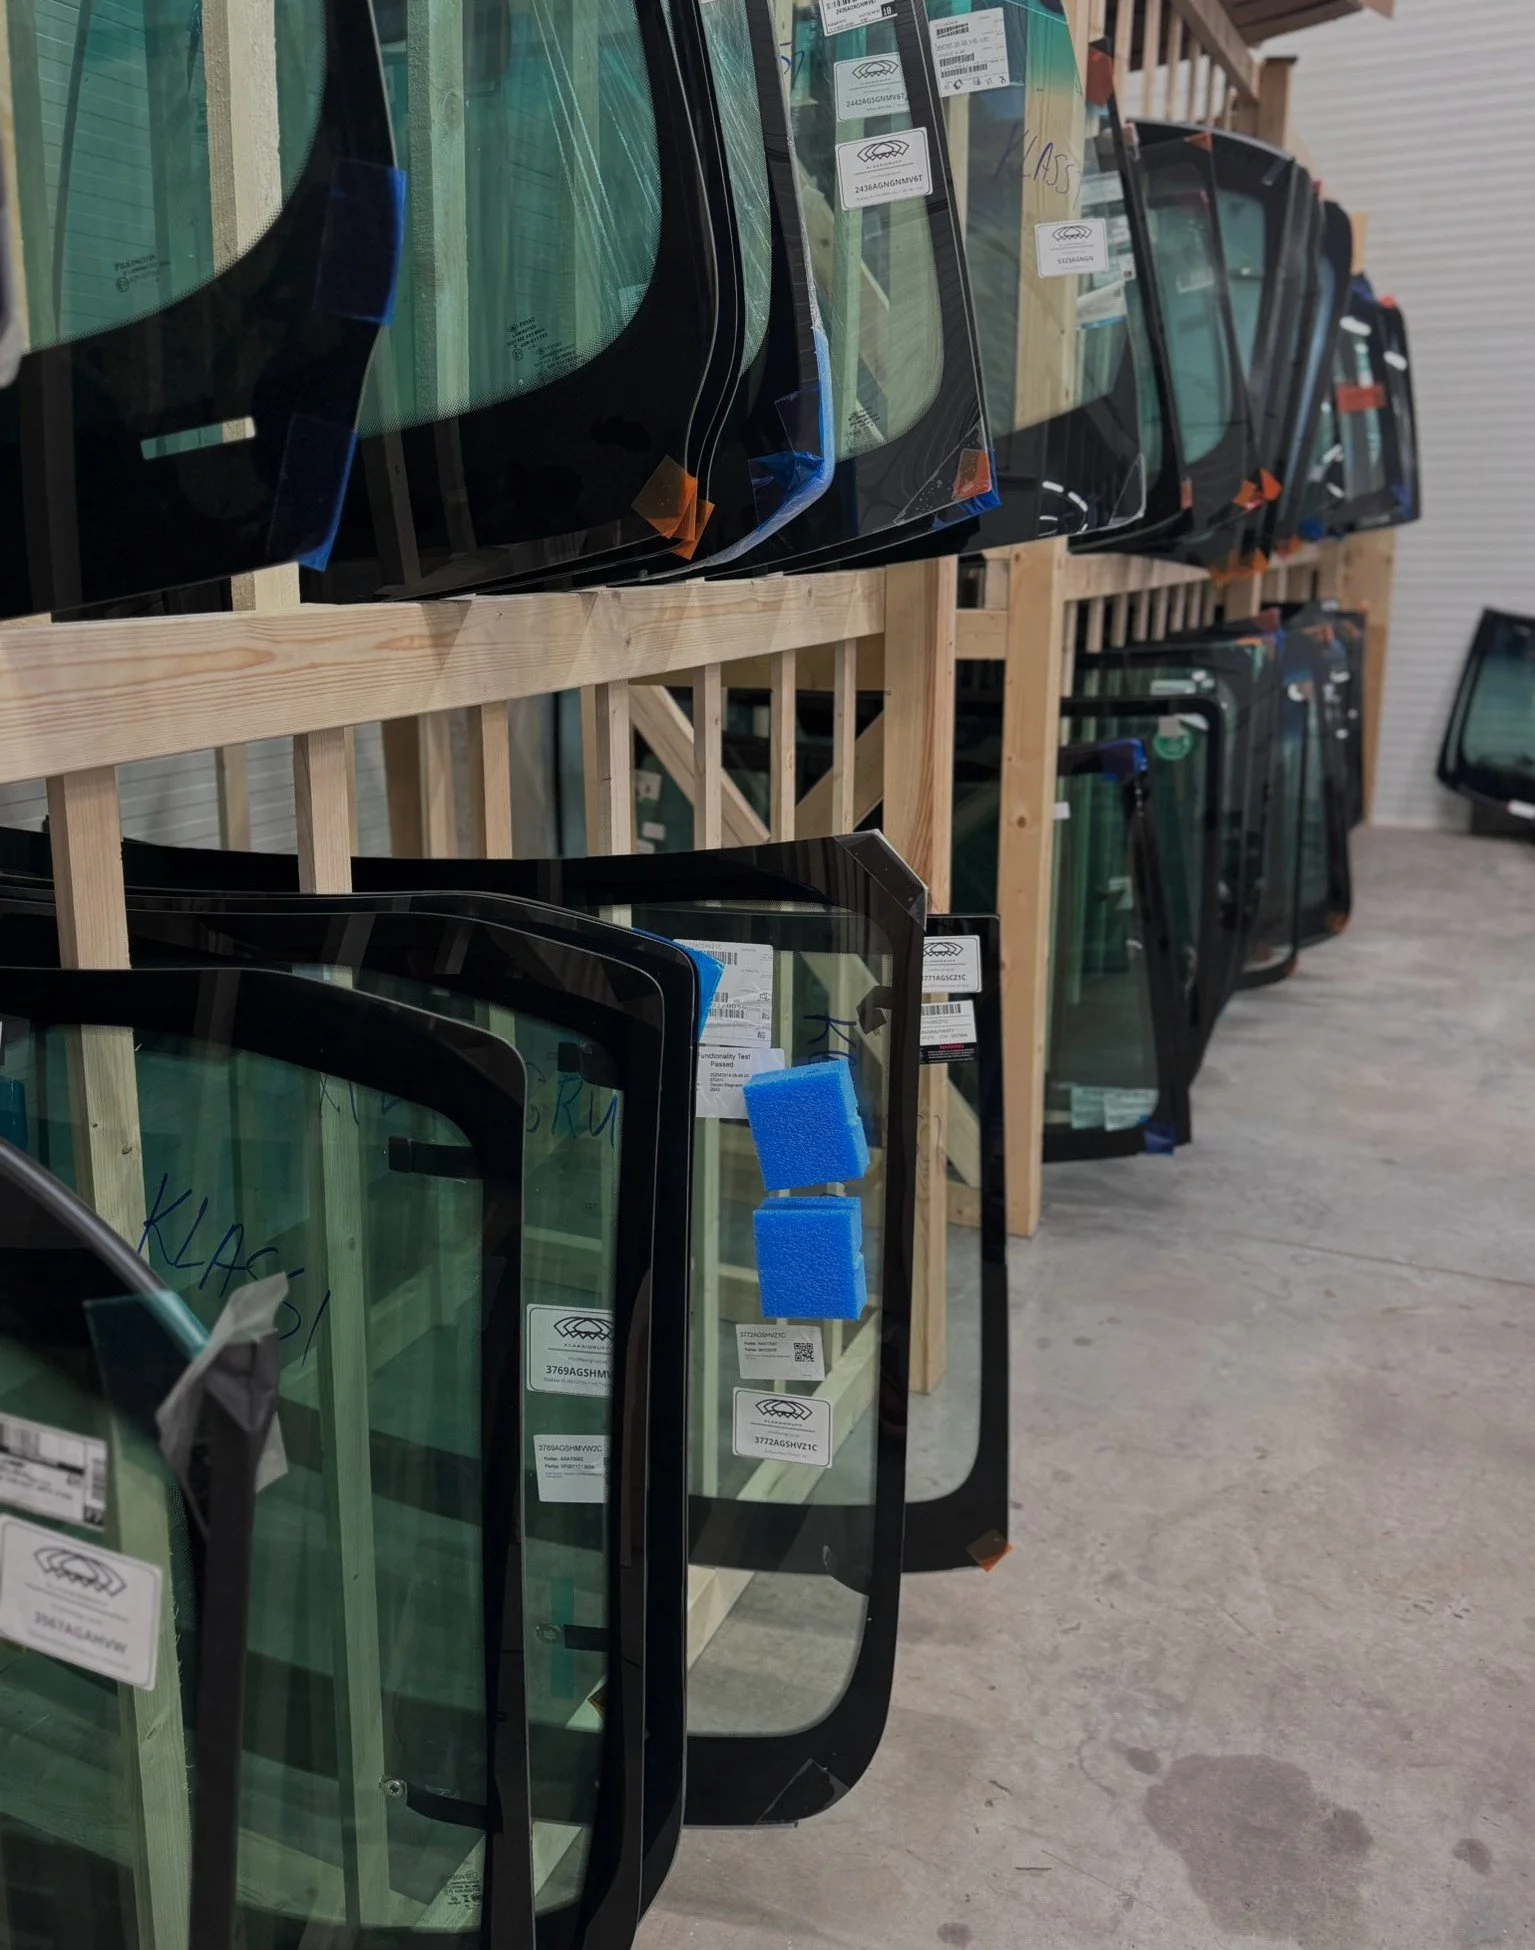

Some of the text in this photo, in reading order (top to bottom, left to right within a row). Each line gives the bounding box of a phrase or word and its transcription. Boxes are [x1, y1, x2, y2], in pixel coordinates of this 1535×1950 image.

[883, 6, 892, 16] 18
[855, 174, 923, 194] 2436AGNGNMV6T
[699, 1052, 751, 1061] unctionality Test
[710, 1060, 734, 1068] Passed
[754, 1436, 818, 1452] 3772AGSHVZ1C
